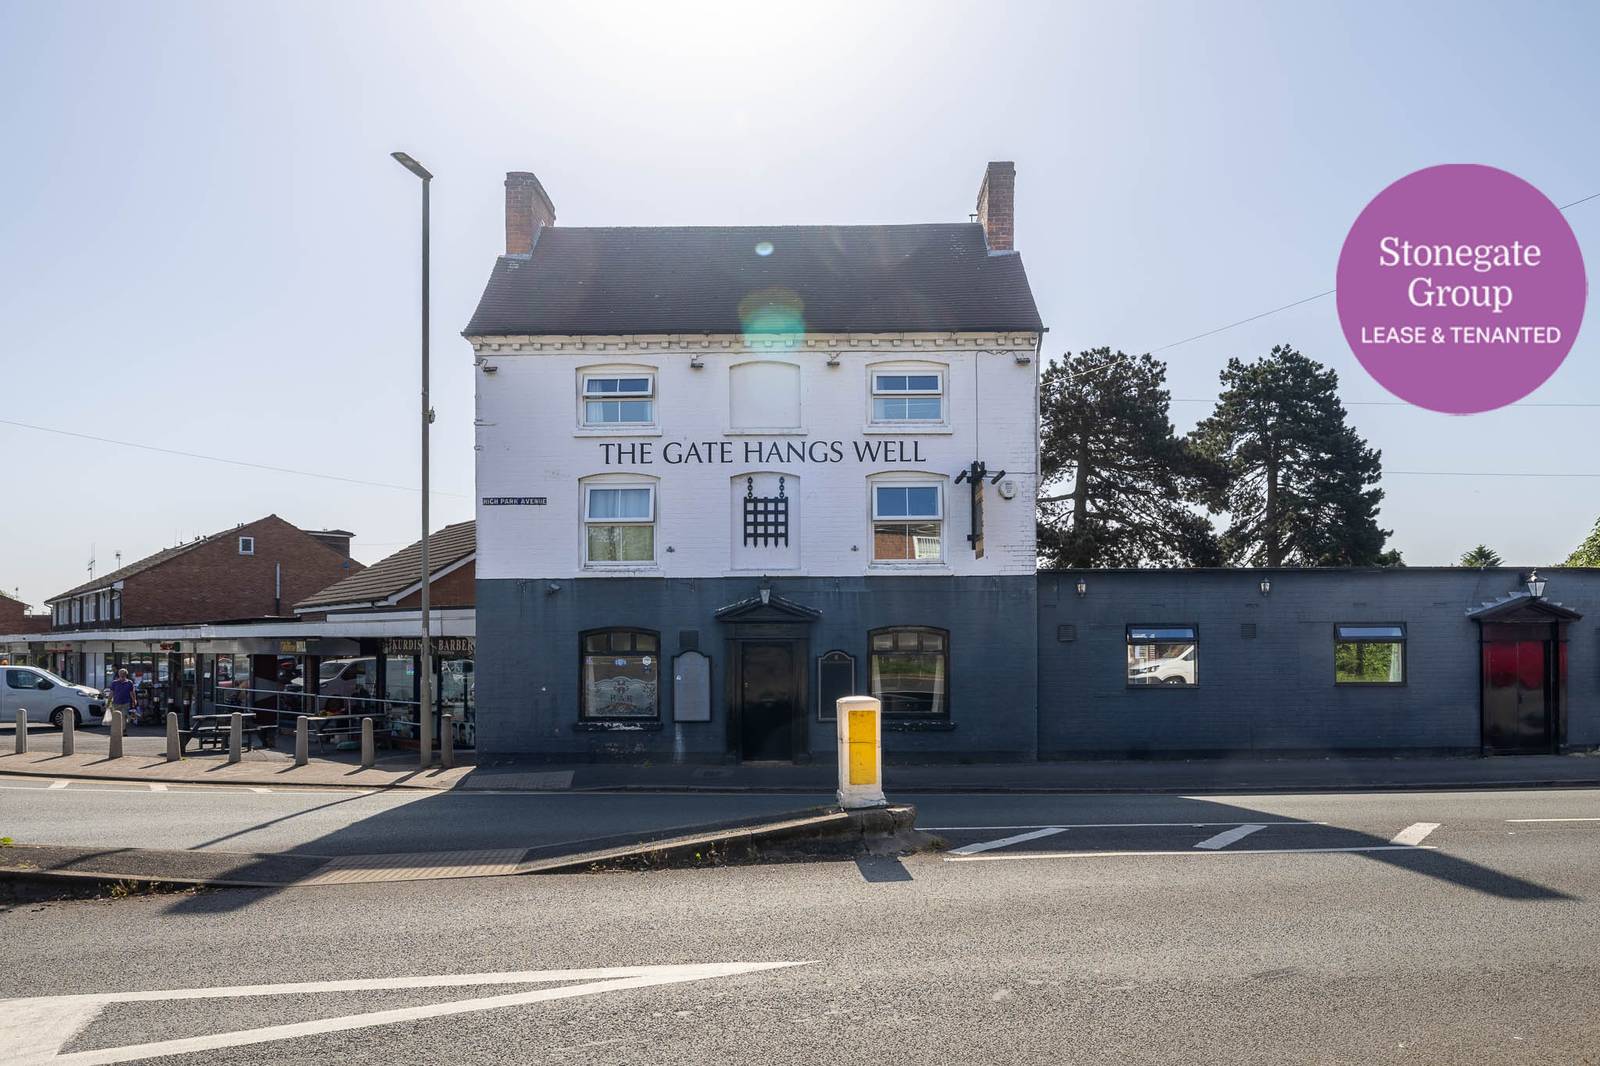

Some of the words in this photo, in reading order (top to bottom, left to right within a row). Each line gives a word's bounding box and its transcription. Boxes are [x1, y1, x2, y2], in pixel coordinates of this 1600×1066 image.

[600, 442, 653, 464] THE
[662, 441, 733, 464] GATE
[744, 440, 843, 463] HANGS
[853, 440, 926, 462] WELL
[392, 639, 423, 650] KURDIS
